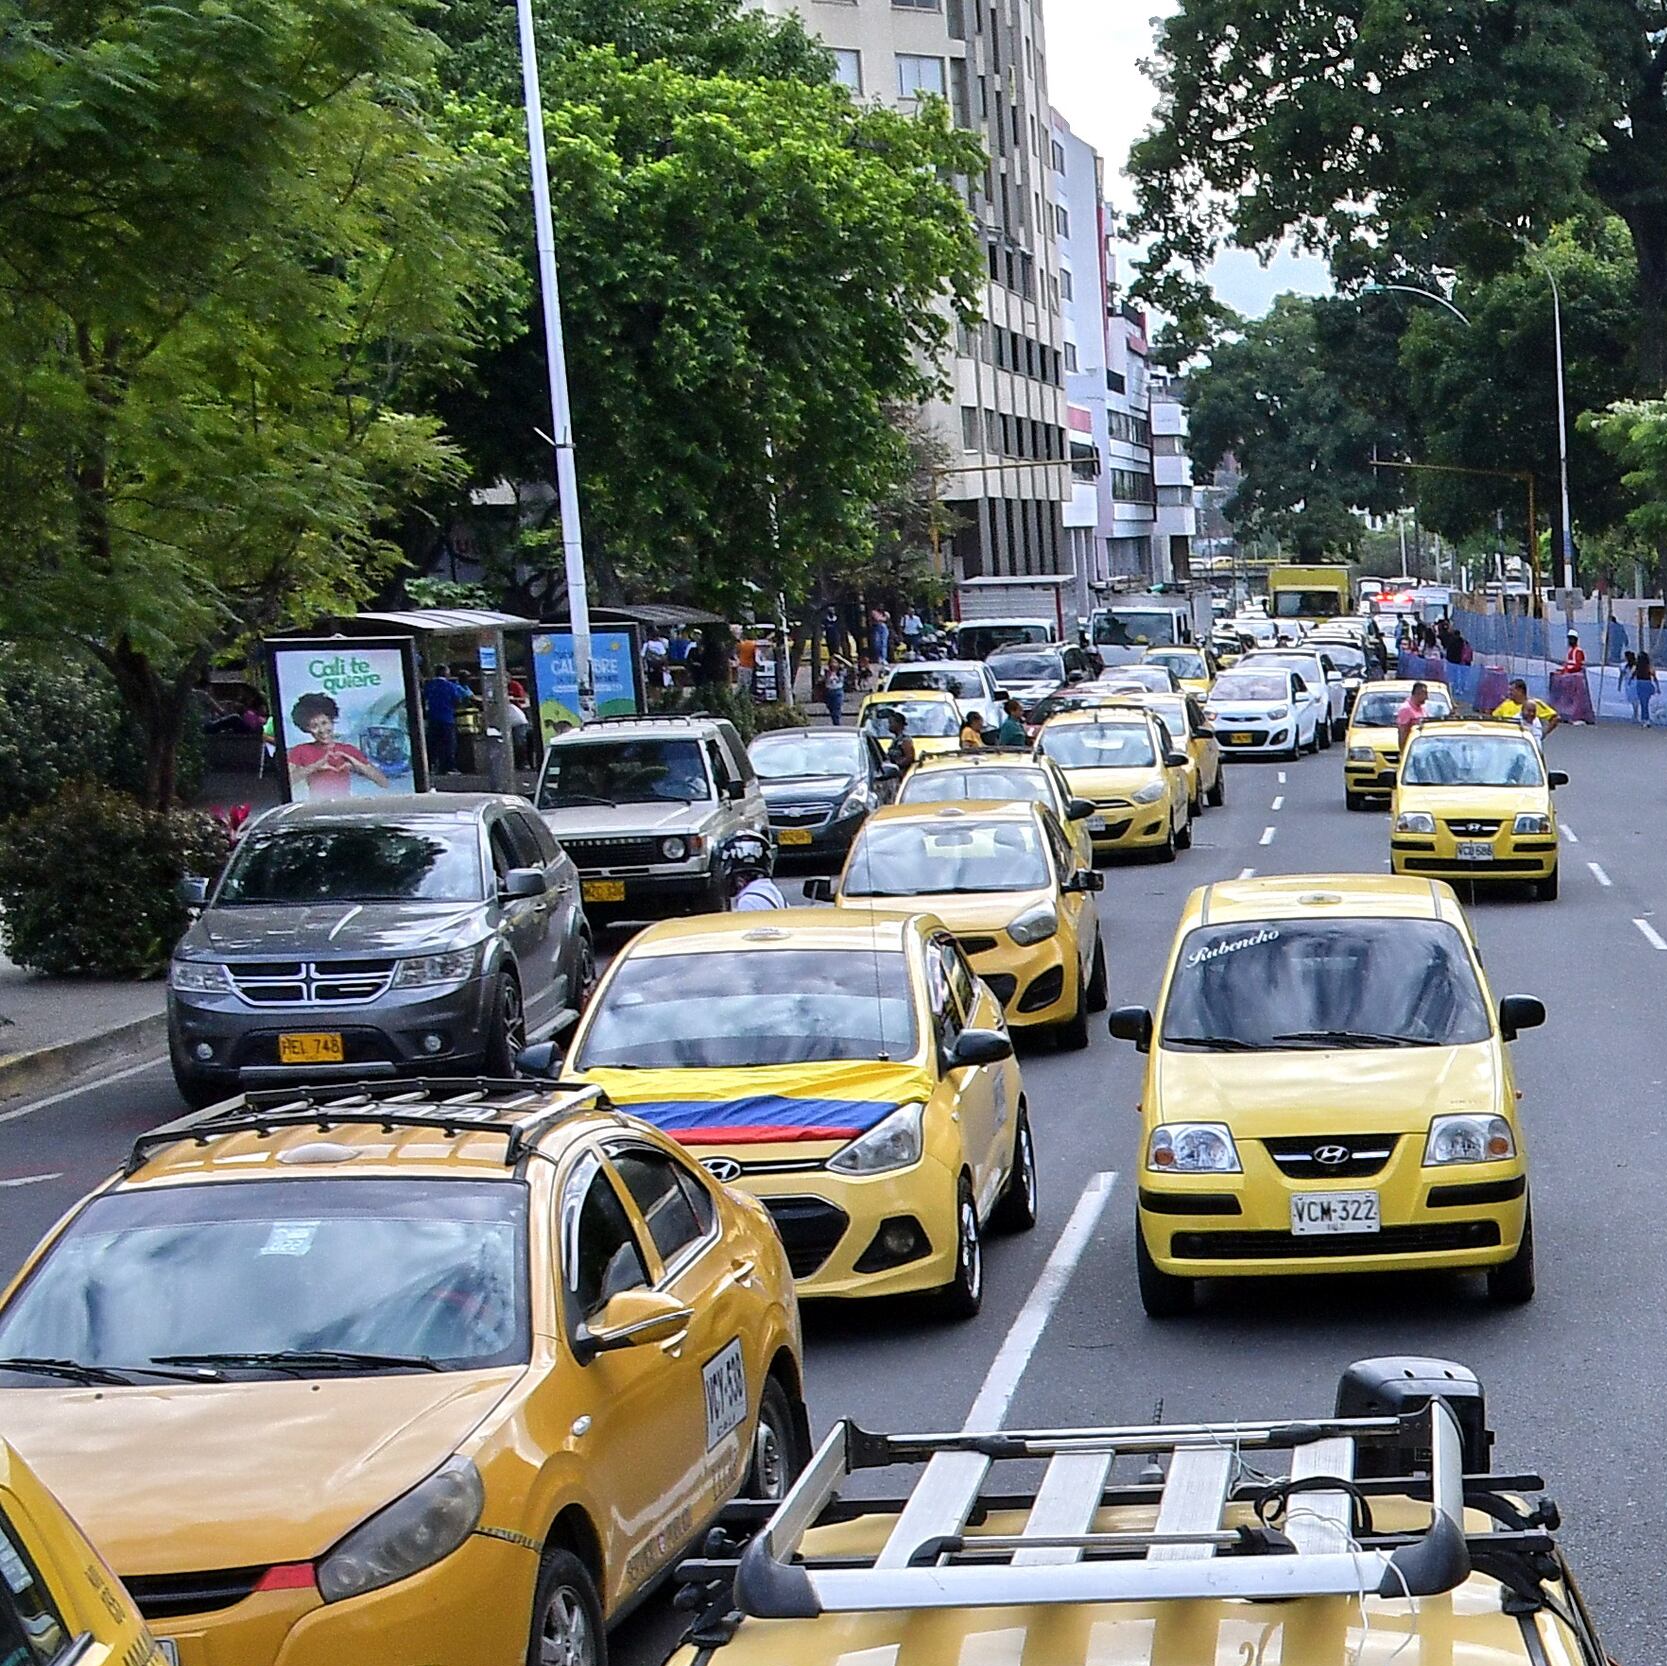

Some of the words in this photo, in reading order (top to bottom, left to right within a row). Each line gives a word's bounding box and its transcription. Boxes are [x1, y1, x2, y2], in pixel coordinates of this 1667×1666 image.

[309, 656, 345, 678] Cali
[351, 656, 370, 674] te
[323, 673, 381, 694] quiere
[1186, 929, 1280, 968] Rubencho
